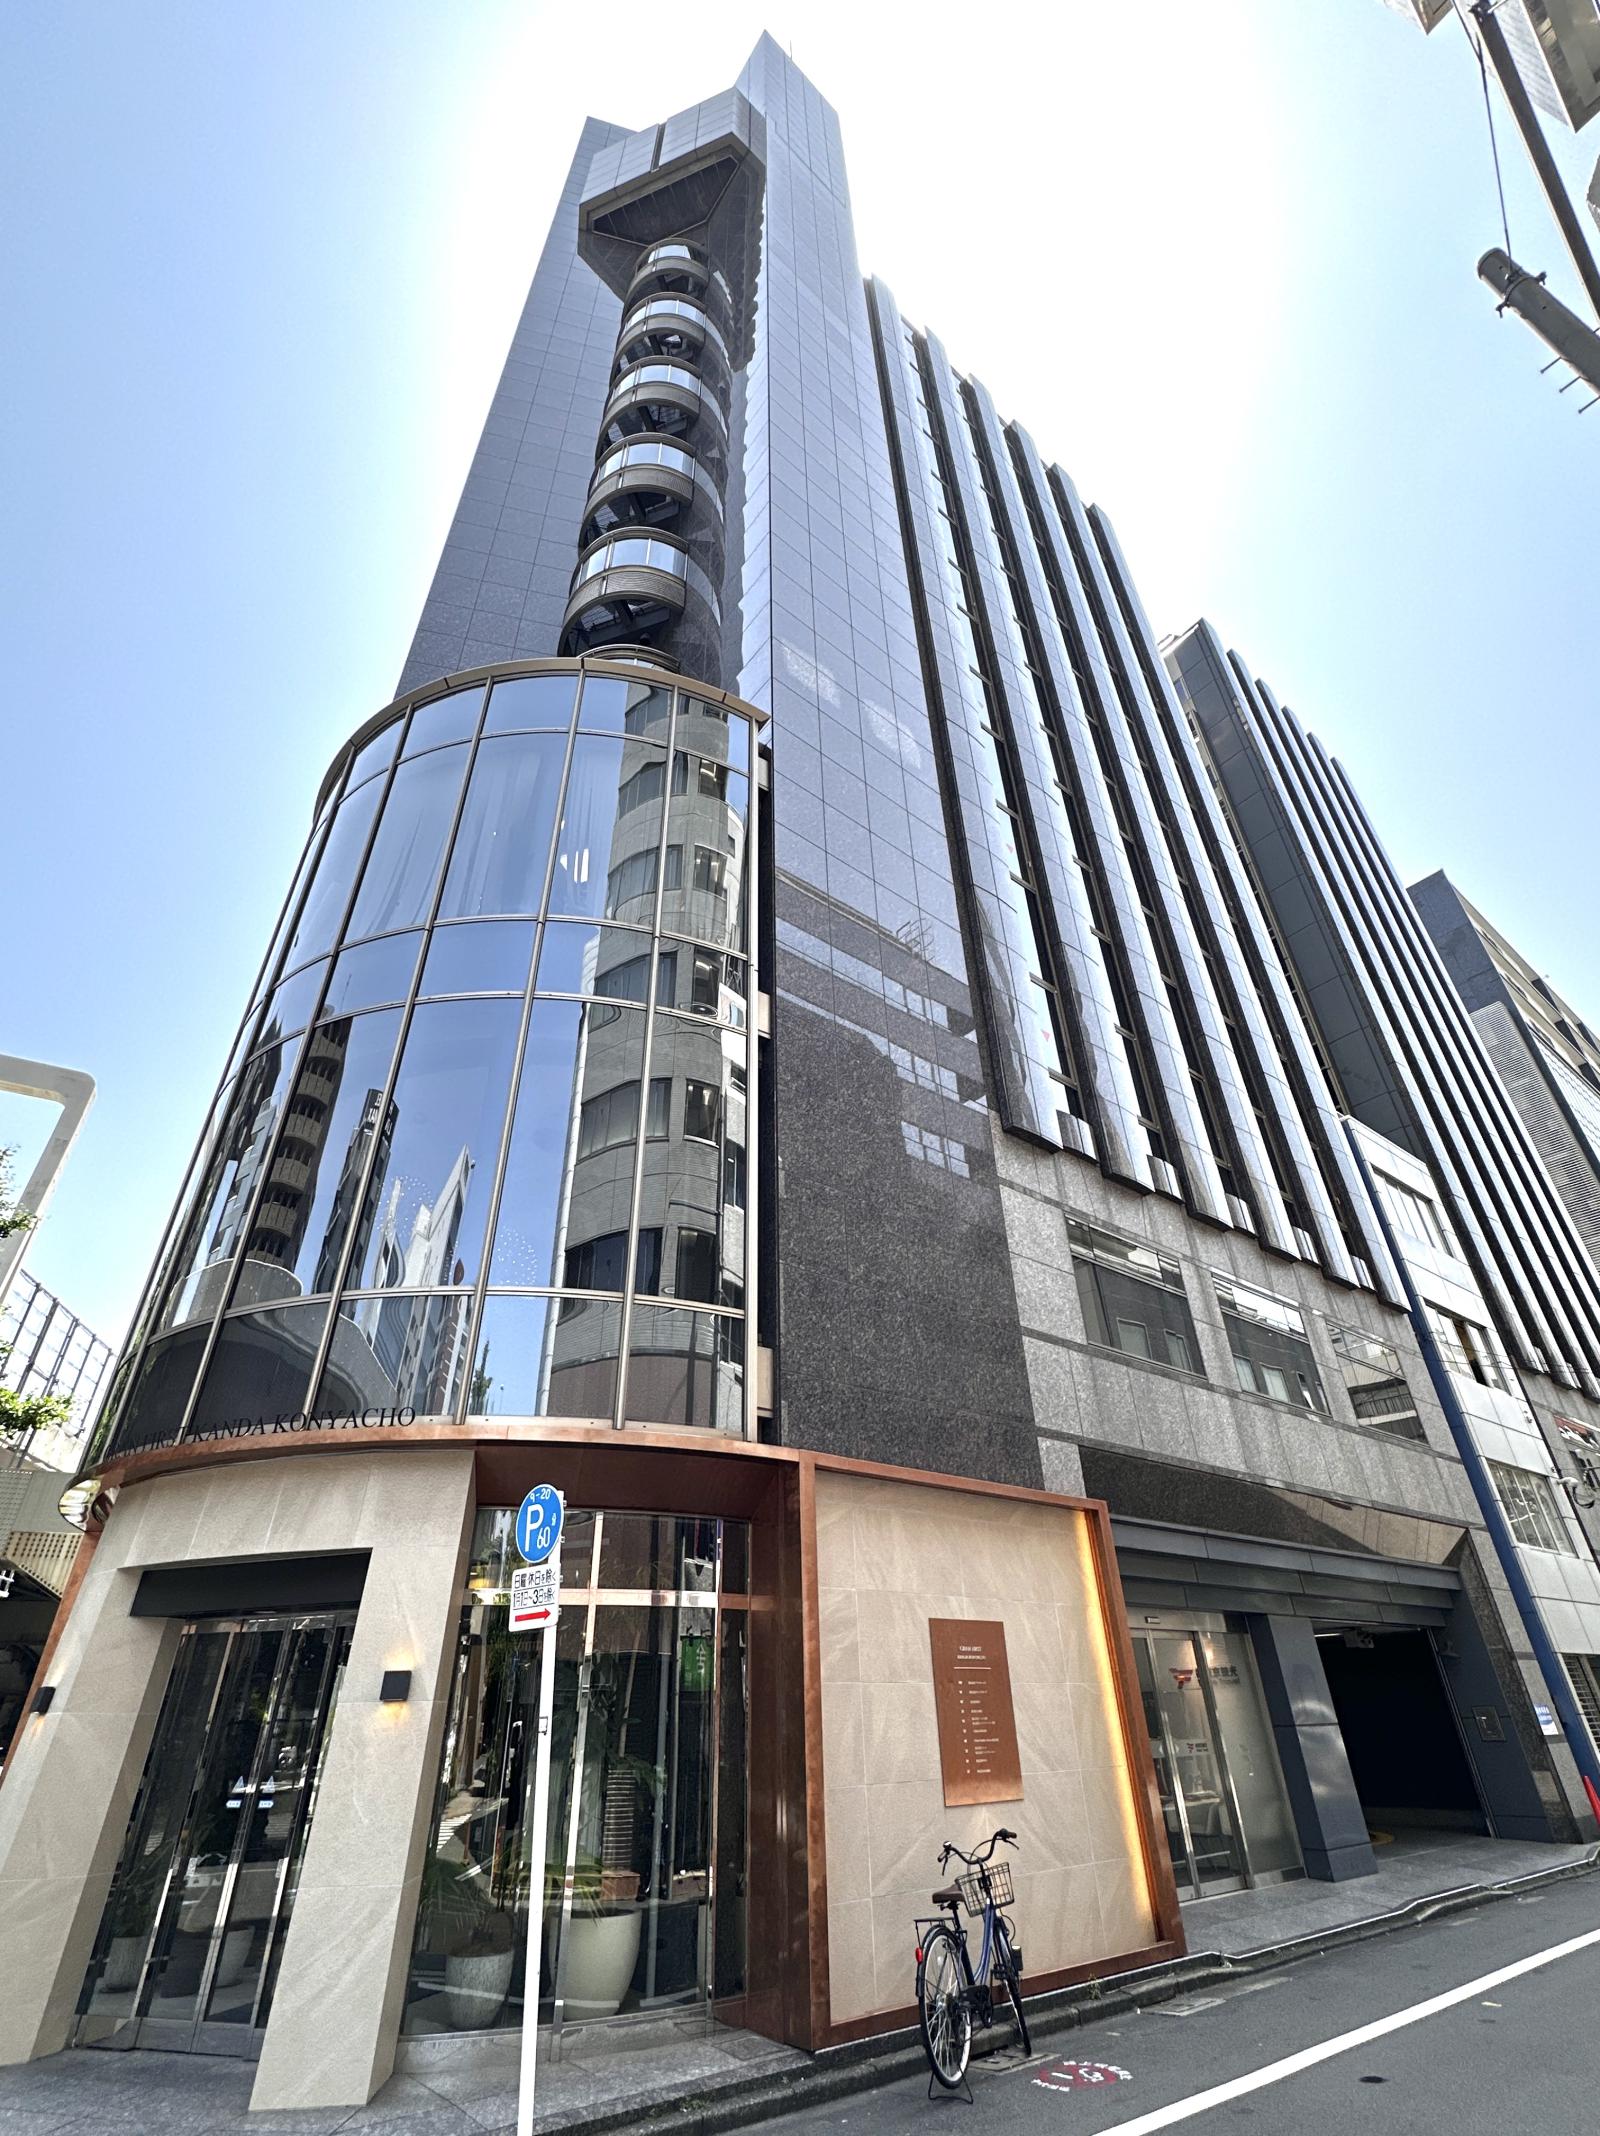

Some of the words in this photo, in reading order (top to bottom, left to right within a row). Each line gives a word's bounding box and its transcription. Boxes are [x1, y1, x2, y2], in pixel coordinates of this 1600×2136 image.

[191, 1416, 266, 1444] KANDA
[271, 1406, 416, 1435] KONYACHO
[530, 1488, 551, 1503] 9-20
[525, 1503, 544, 1552] P
[536, 1526, 551, 1549] 60
